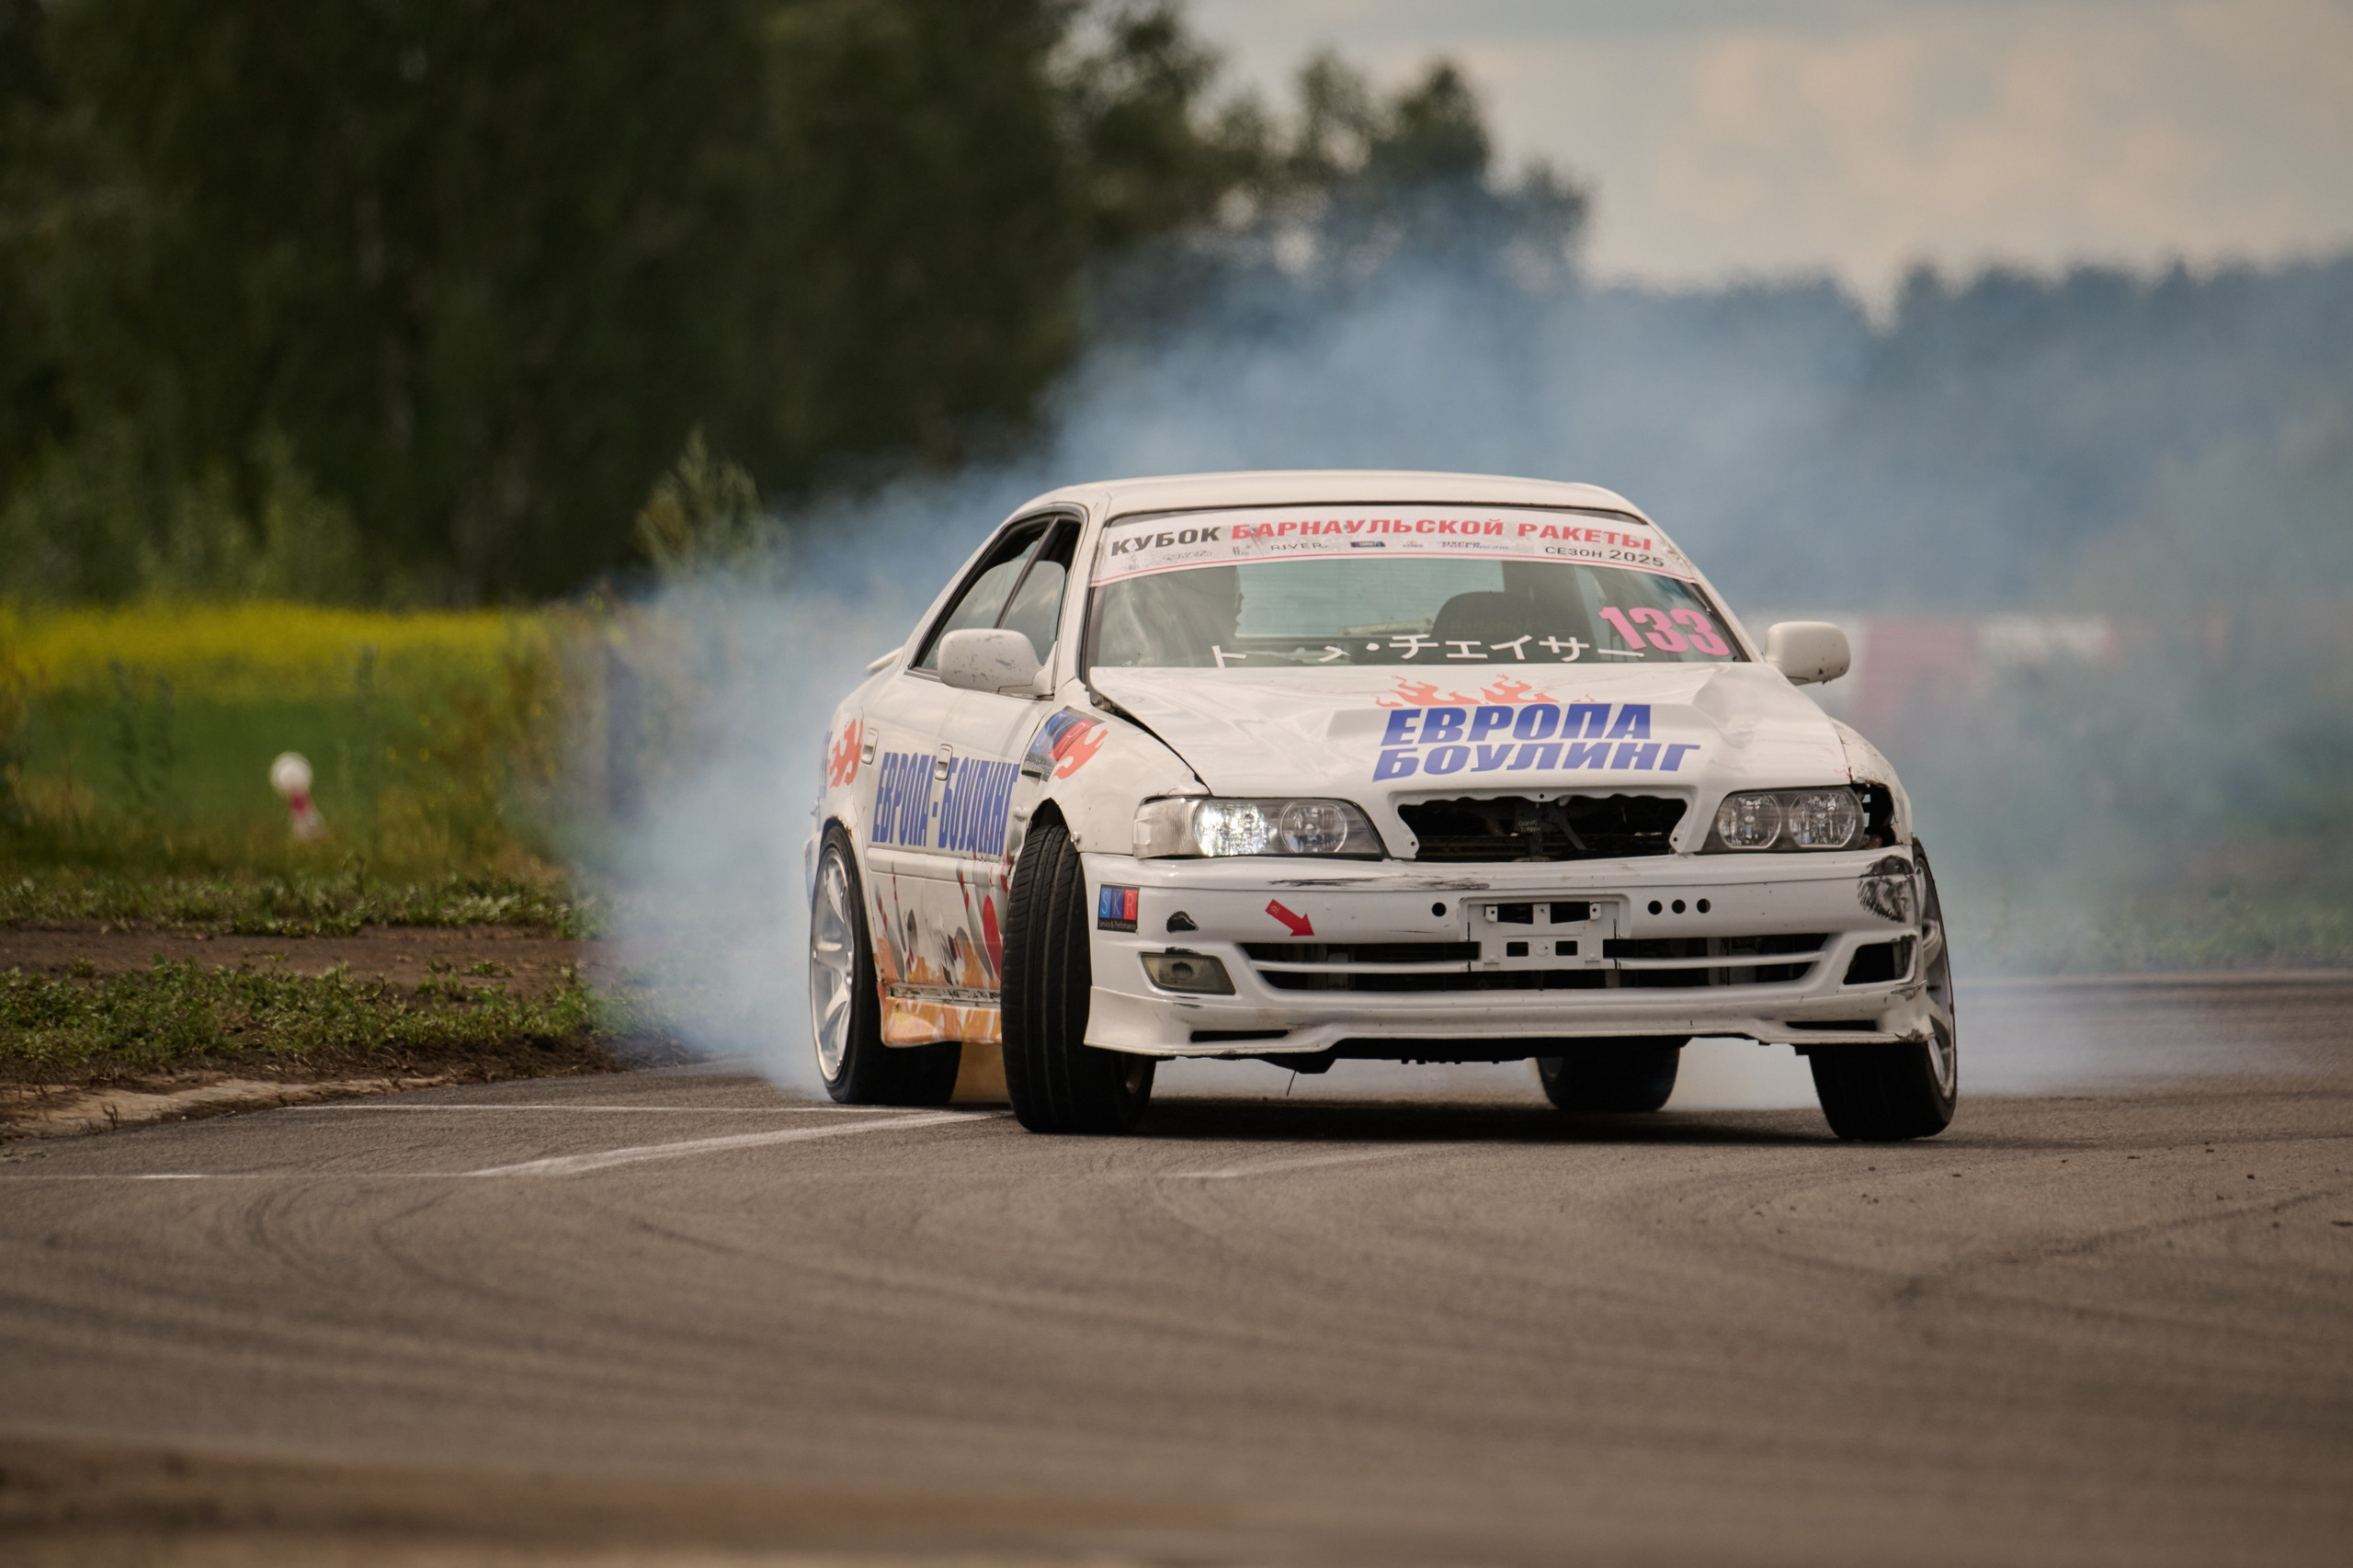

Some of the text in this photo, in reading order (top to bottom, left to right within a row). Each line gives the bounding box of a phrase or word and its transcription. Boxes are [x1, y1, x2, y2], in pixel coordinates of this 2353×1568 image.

[1110, 518, 1652, 556] КУБОК БАРНАУЛЬСКОЙ РАКЕТЫ
[1545, 546, 1665, 567] СЕЗОН 2025
[1599, 607, 1731, 656] 133
[1381, 703, 1652, 746] ЕВРОПА
[1372, 742, 1700, 782] БОУЛИНГ
[1101, 891, 1135, 915] SKR
